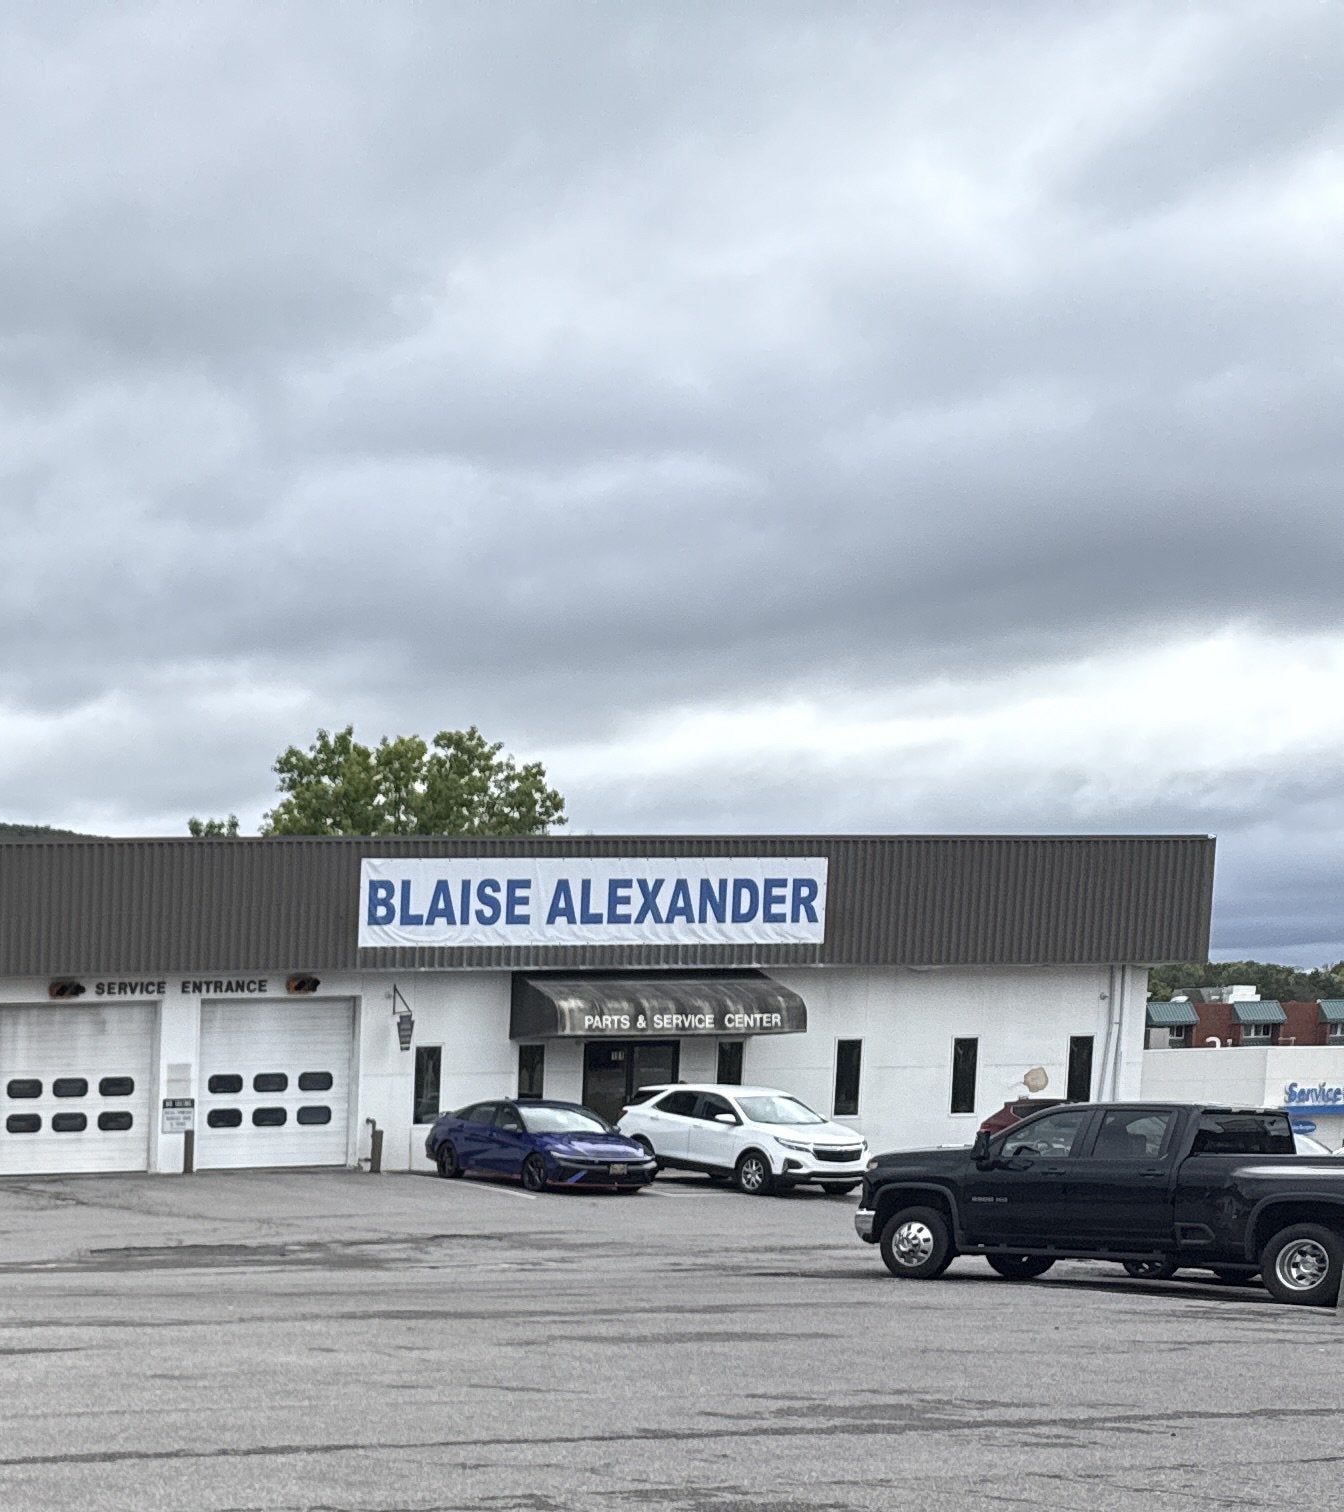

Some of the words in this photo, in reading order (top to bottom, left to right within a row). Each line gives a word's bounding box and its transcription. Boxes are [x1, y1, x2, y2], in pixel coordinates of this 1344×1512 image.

[367, 878, 532, 926] BLAISE
[546, 878, 819, 925] ALEXANDER
[95, 981, 167, 995] SERVICE
[181, 979, 268, 994] ENTRANCE
[584, 1014, 630, 1029] PARTS
[636, 1014, 647, 1029] &
[653, 1013, 715, 1028] SERVICE
[724, 1013, 782, 1028] CENTER
[1285, 1081, 1342, 1104] Service
